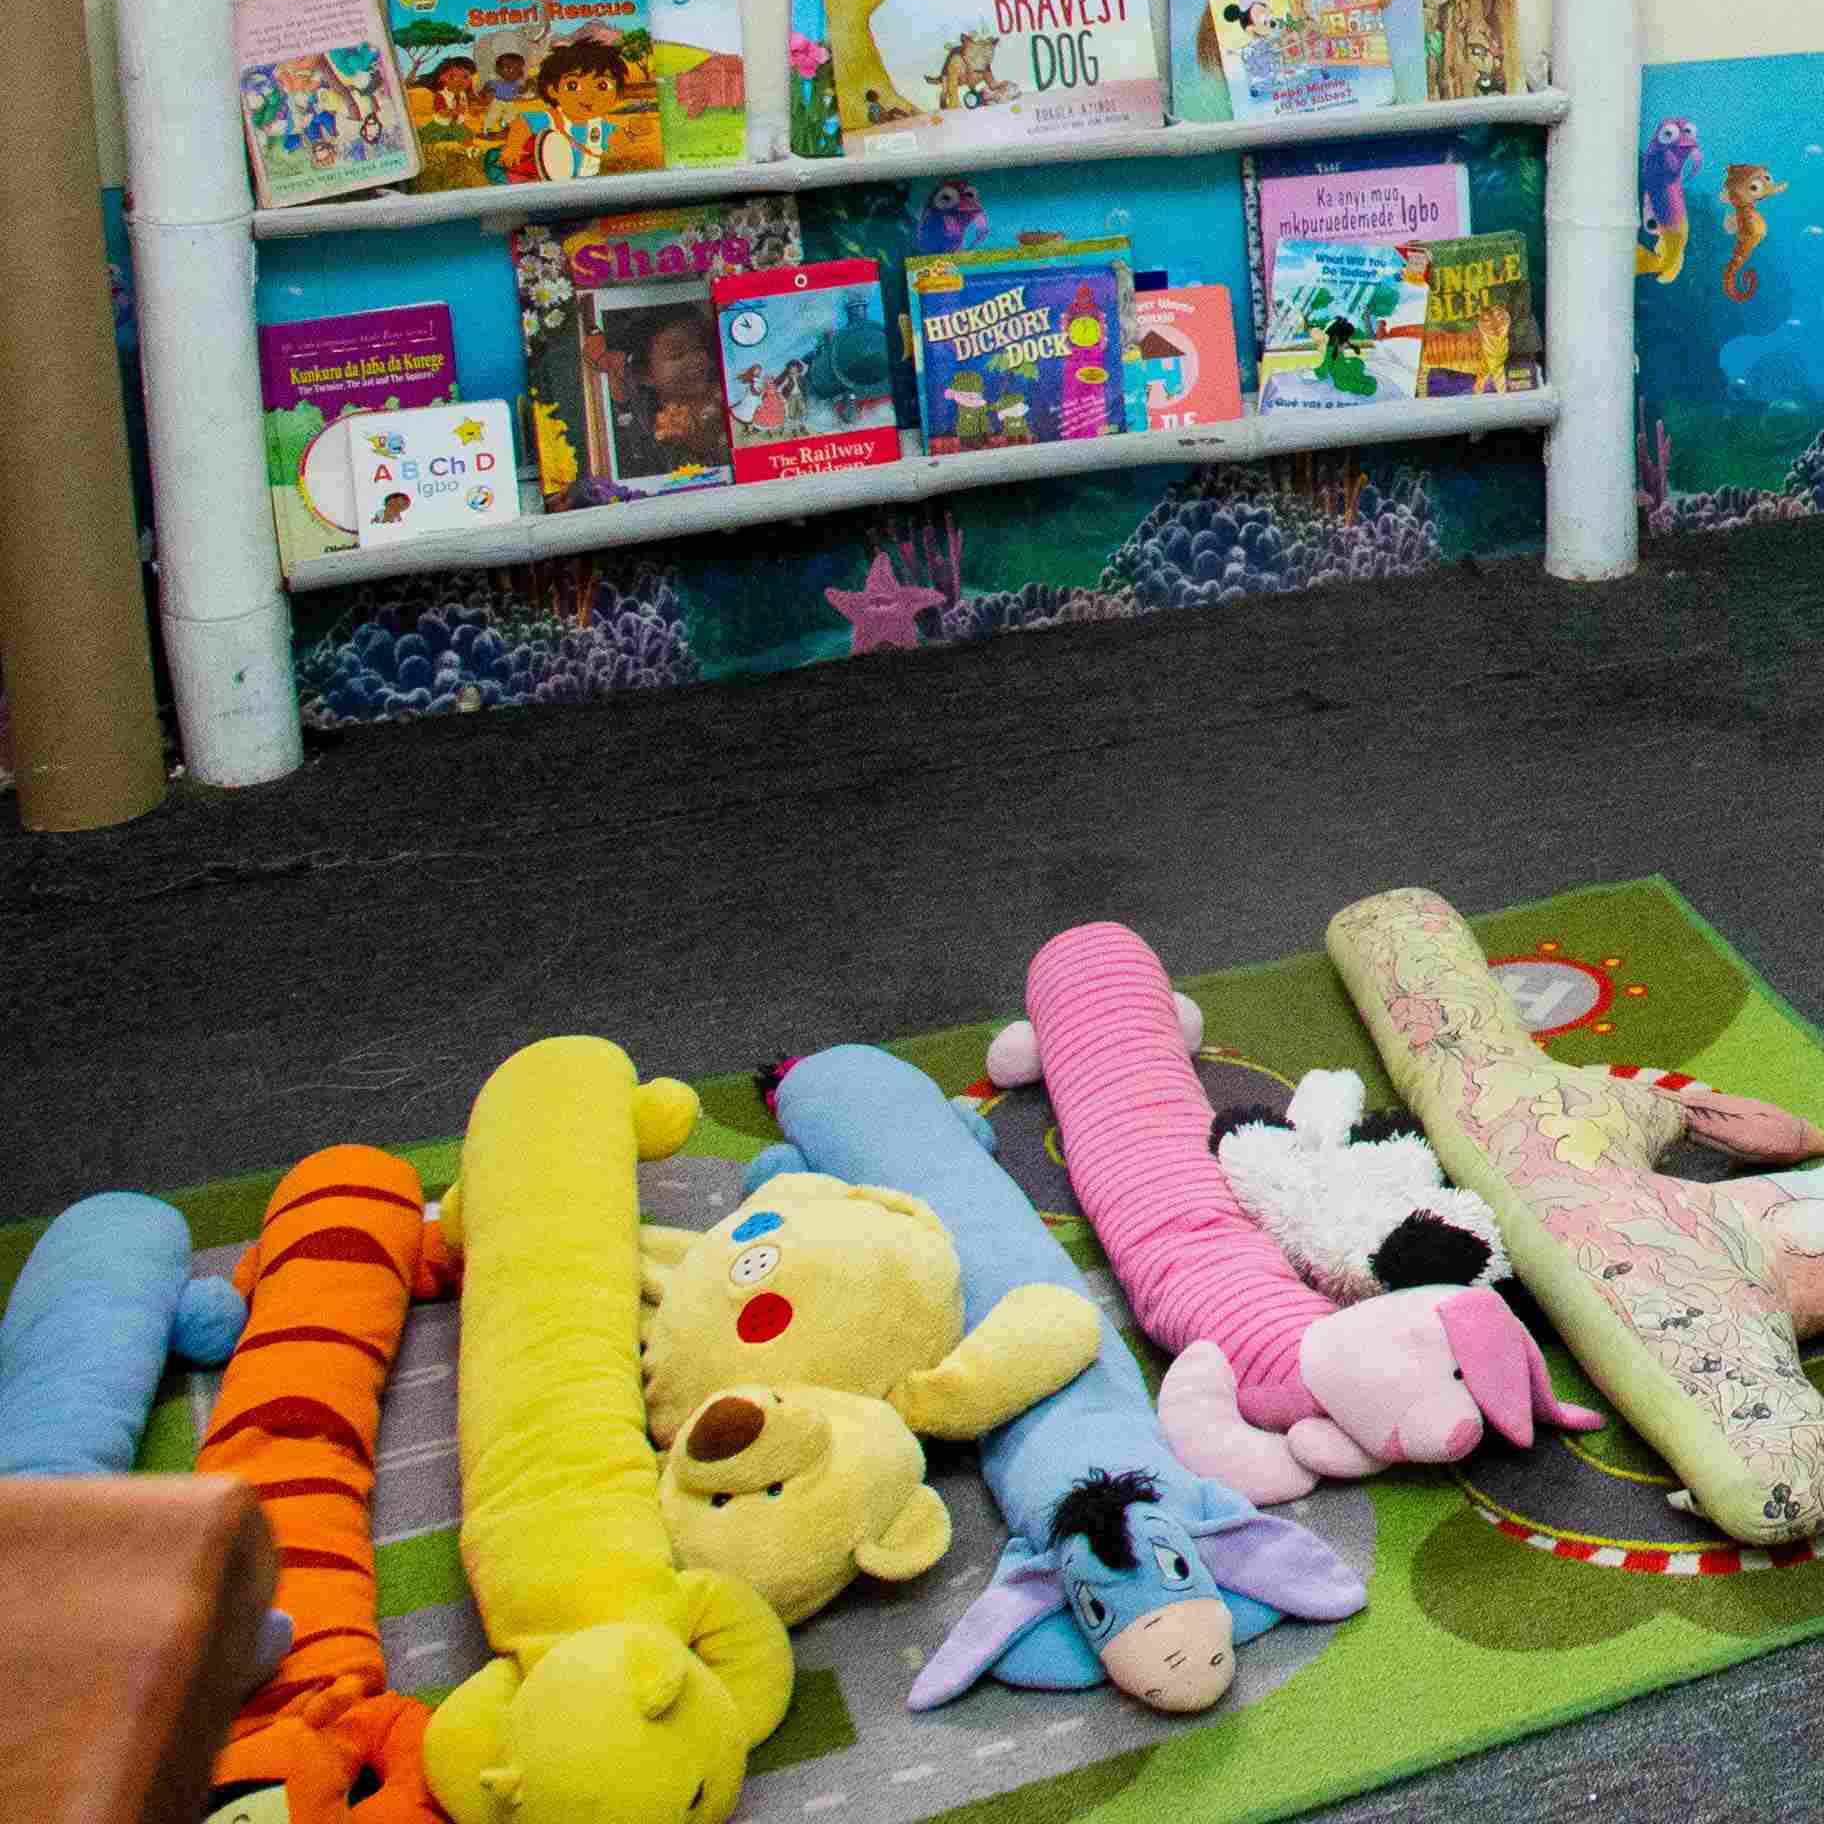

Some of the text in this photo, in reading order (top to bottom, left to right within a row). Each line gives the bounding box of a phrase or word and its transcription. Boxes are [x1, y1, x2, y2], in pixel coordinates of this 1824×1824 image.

[468, 5, 537, 27] Safari
[1031, 30, 1099, 92] DOG
[1402, 195, 1440, 231] Igbo
[572, 236, 751, 286] Share
[924, 288, 1026, 343] HICKORY
[955, 307, 1052, 362] DICKORY
[1005, 332, 1072, 369] DOCK
[373, 452, 496, 482] A B Ch D
[768, 442, 876, 467] The Railway
[417, 480, 459, 498] Igbo
